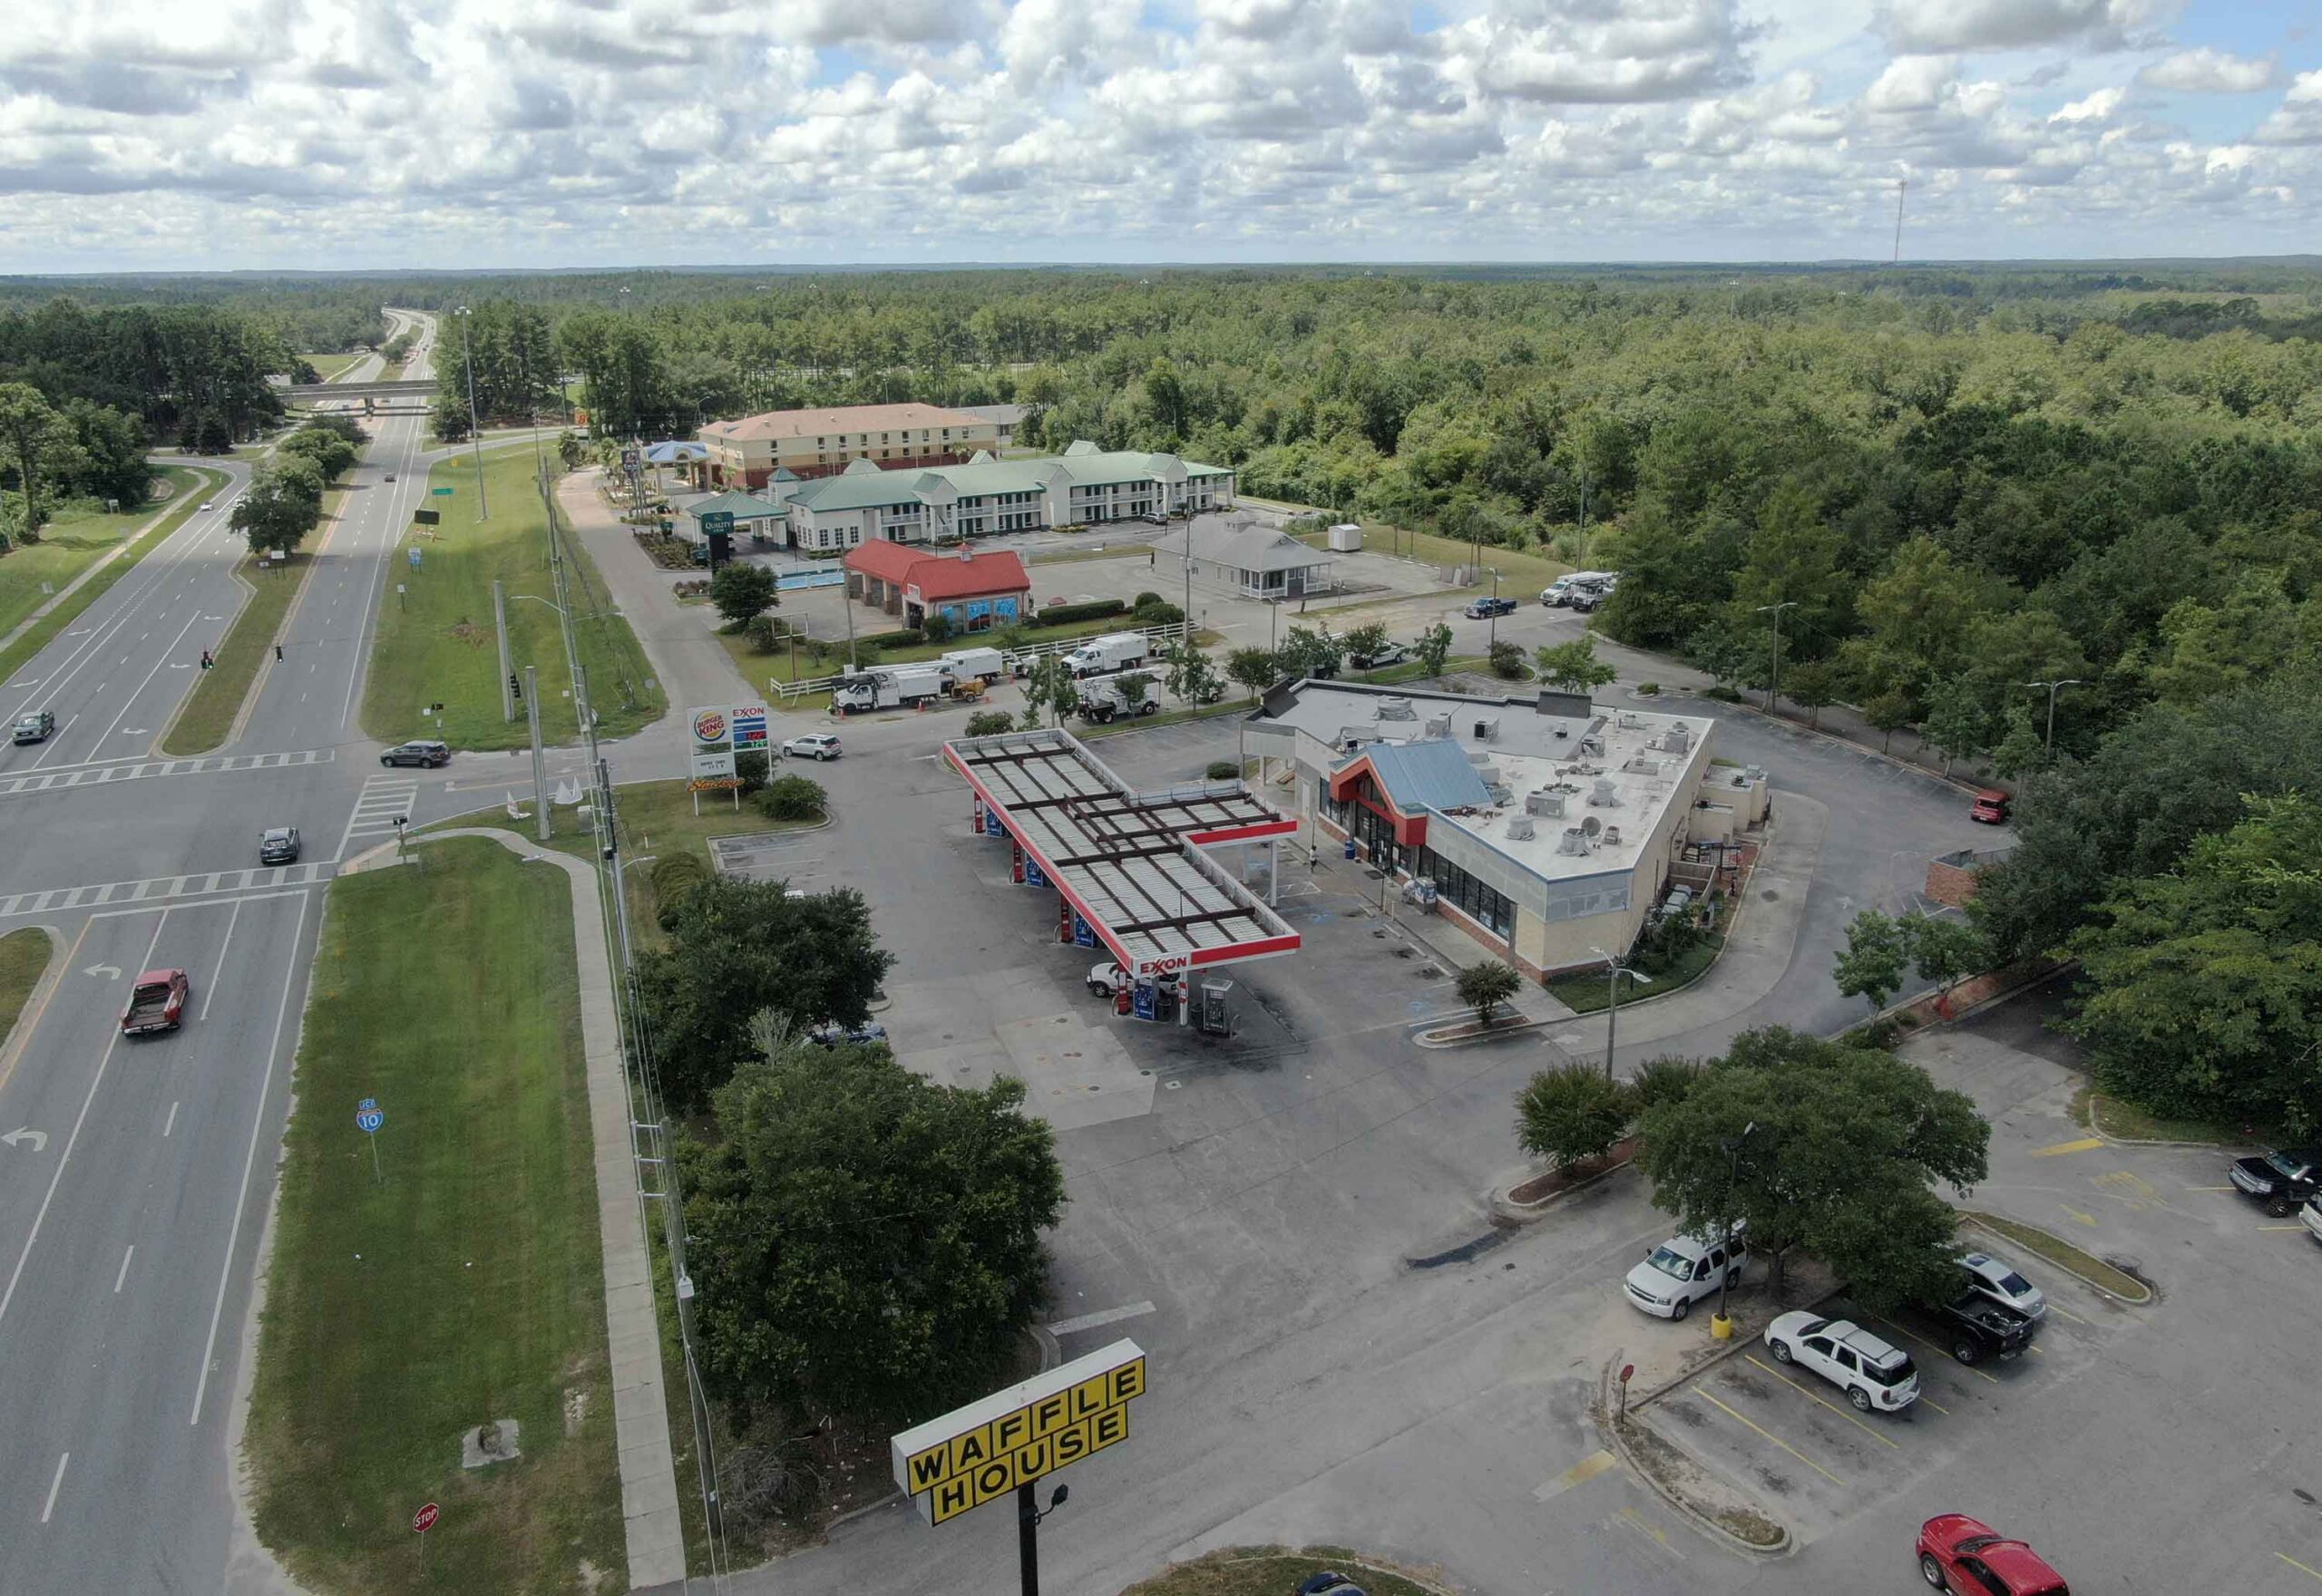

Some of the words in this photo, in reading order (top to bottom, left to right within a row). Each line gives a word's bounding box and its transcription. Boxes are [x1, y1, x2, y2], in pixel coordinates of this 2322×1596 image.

[732, 707, 765, 717] EXXON
[697, 715, 723, 728] BURGER
[699, 721, 724, 736] KING
[1140, 957, 1187, 975] EXXON
[362, 1115, 379, 1128] 10
[913, 1366, 1137, 1484] WAFFLE
[941, 1411, 1119, 1514] HOUSE
[415, 1508, 436, 1527] STOP
